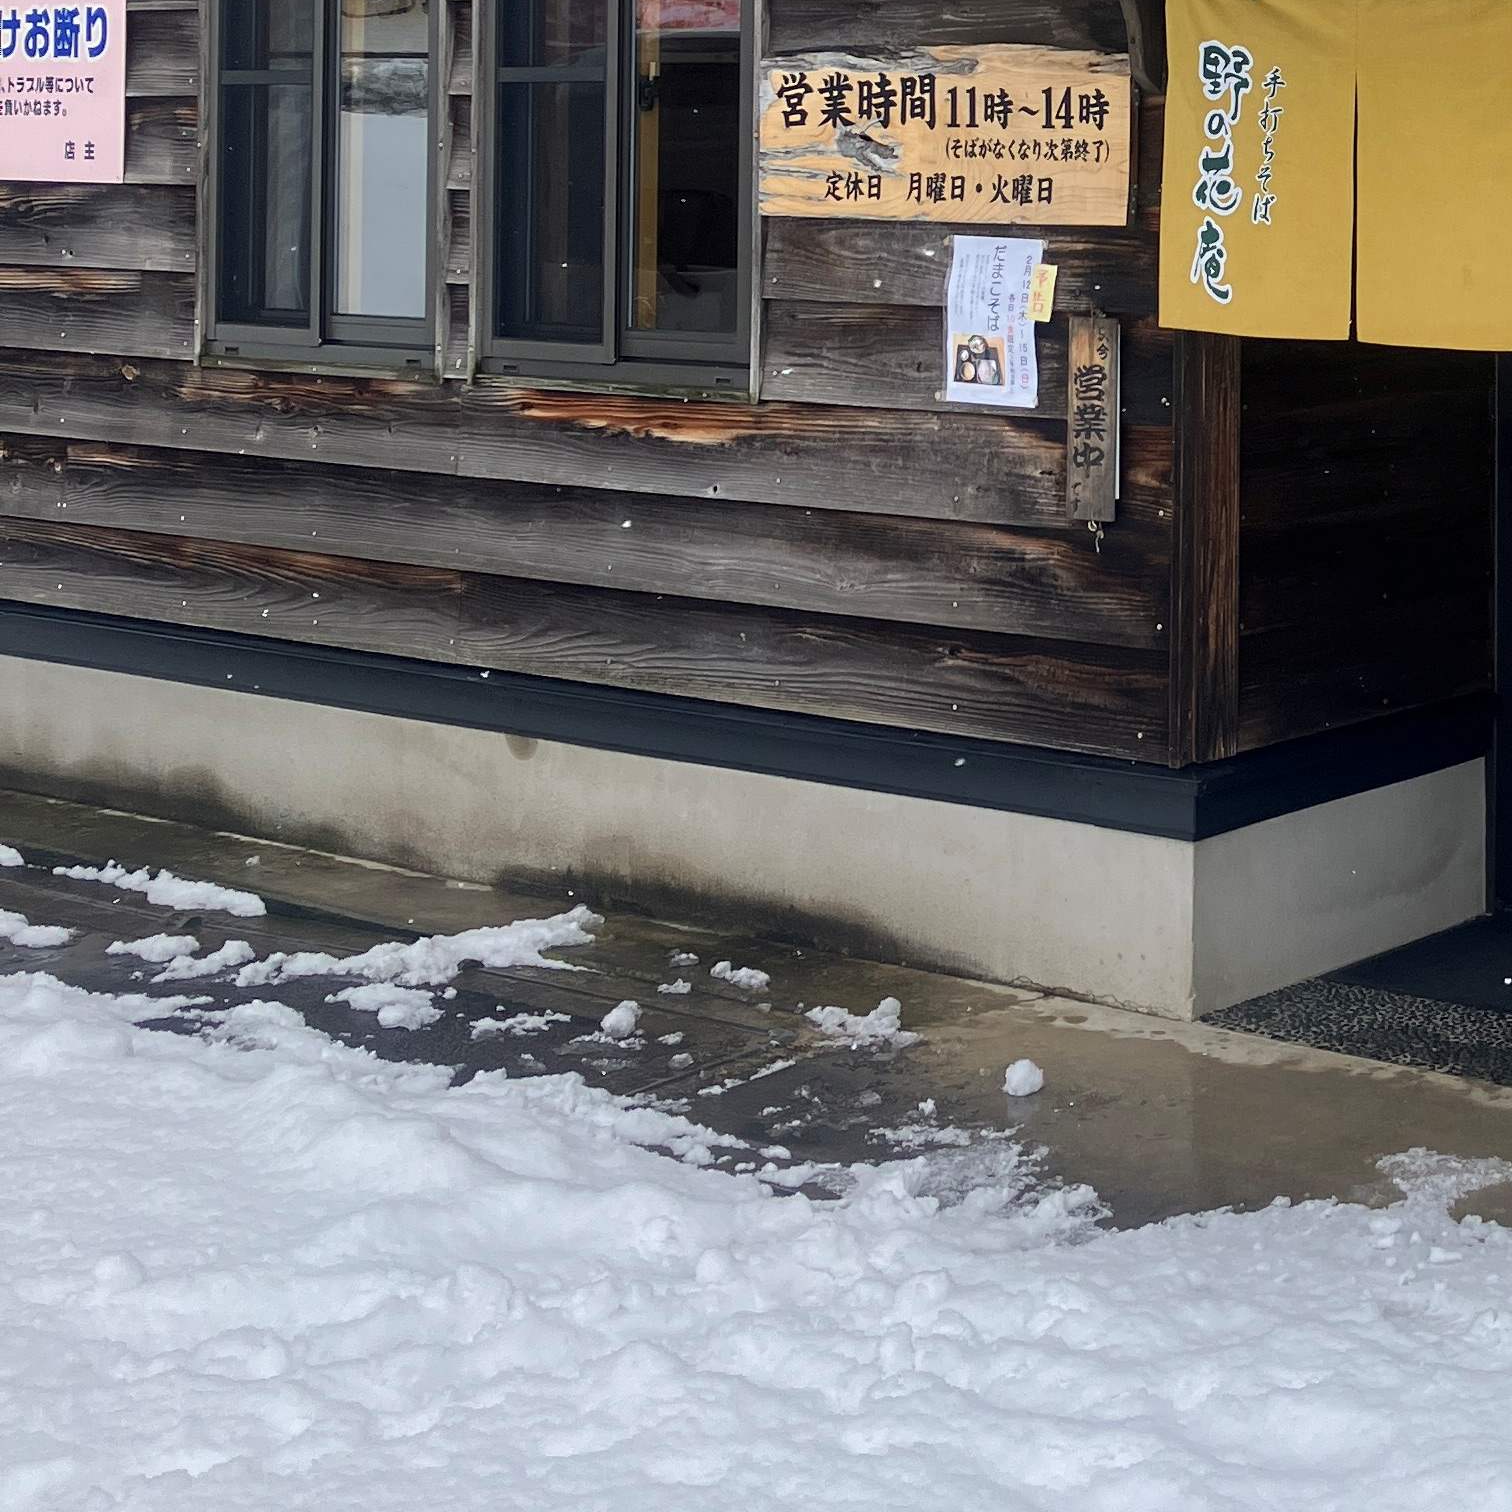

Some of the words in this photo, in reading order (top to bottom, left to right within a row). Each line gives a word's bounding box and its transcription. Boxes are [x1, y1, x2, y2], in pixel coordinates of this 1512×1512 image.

[775, 72, 937, 131] 営業時間
[1253, 65, 1286, 224] 手打ちそば
[824, 170, 882, 202] 定休日
[904, 172, 1054, 206] 月曜日・火曜日
[1191, 43, 1252, 302] 野の花庵
[1072, 363, 1108, 479] 営業中
